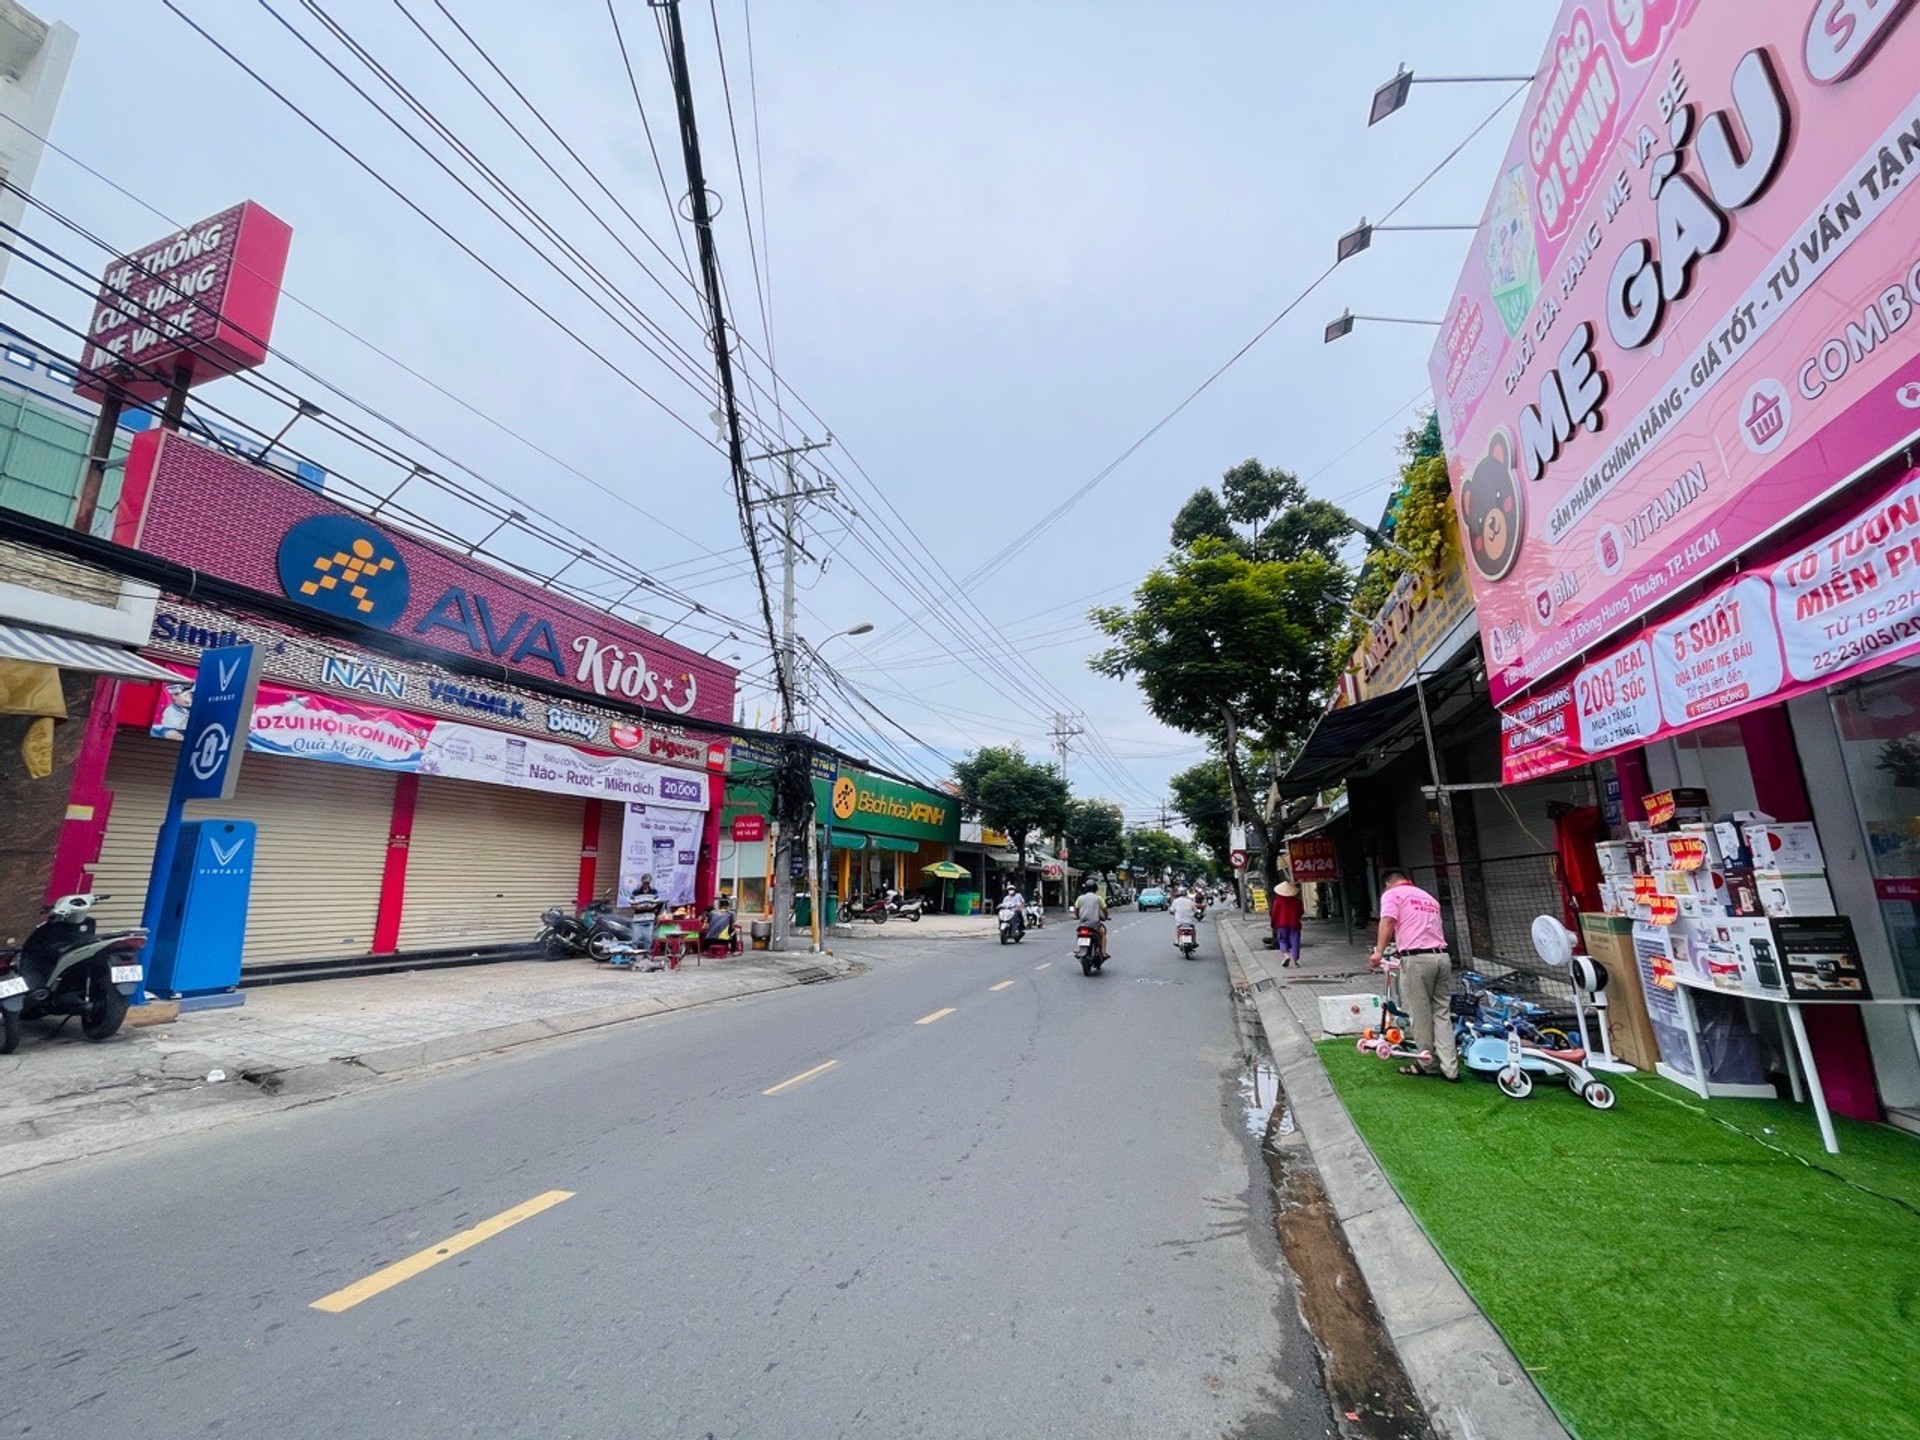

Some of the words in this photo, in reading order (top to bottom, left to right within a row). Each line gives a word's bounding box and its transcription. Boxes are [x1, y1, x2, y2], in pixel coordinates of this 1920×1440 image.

[1559, 56, 1616, 184] SINH
[1518, 321, 1607, 481] MẸ
[1605, 46, 1790, 350] GẤU
[1550, 509, 1572, 536] SẢN
[1601, 434, 1641, 483] CHÍNH
[1639, 387, 1683, 445] HÃNG
[1689, 339, 1722, 388] GIÁ
[1718, 302, 1757, 355] TỐT
[1767, 248, 1801, 301] TƯ
[1799, 190, 1862, 264] VẤN
[1624, 460, 1709, 548] VITAMIN
[1684, 528, 1721, 568] HCM
[1828, 493, 1920, 565] TƯỢN
[1796, 562, 1878, 621] MIỄN
[414, 585, 565, 677] AVA
[572, 635, 658, 702] Kids
[1615, 647, 1645, 678] DEAL
[1673, 631, 1686, 661] 5
[321, 656, 407, 699] NAN
[1580, 668, 1615, 717] 200
[256, 714, 305, 731] DZUI
[347, 722, 384, 742] KON
[547, 706, 600, 740] Bobby
[858, 790, 887, 815] Bách
[906, 801, 945, 826] XANH
[1294, 858, 1334, 871] 24/24
